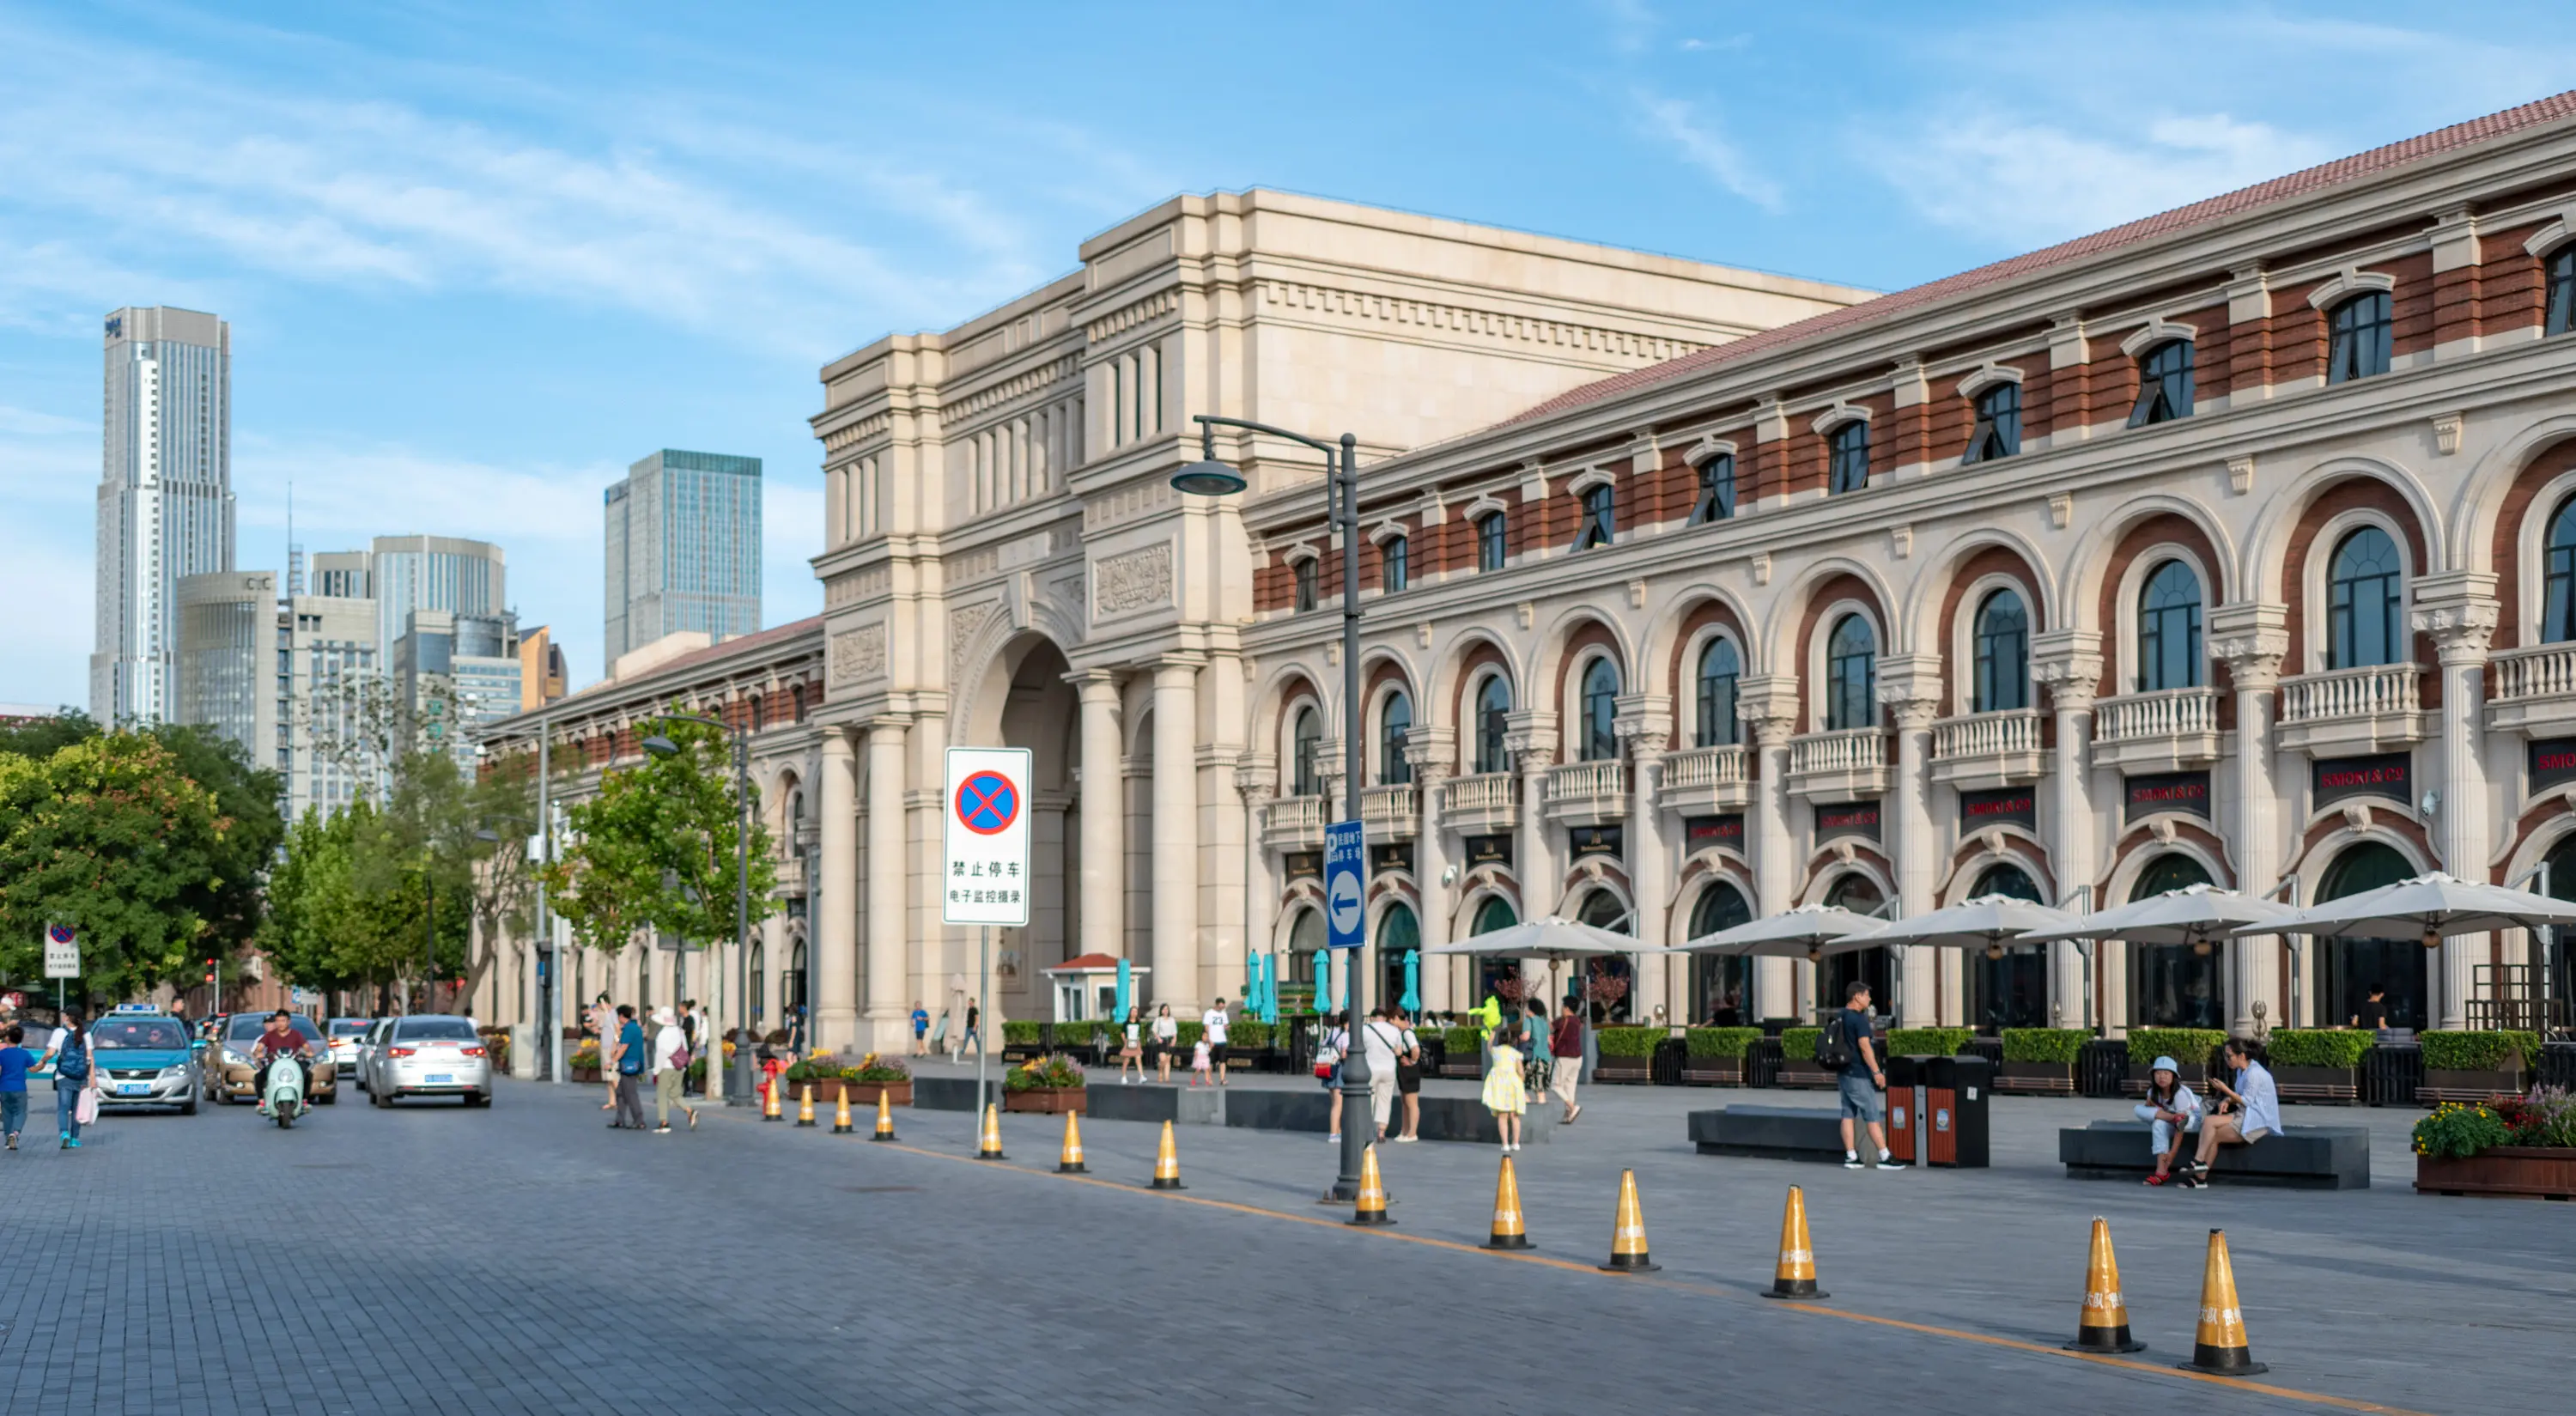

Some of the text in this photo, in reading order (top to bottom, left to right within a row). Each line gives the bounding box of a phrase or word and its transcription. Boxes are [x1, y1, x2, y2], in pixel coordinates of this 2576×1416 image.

[2322, 770, 2369, 788] SMOKI
[2371, 769, 2383, 783] &
[2132, 787, 2173, 803] SMOKI
[2175, 786, 2186, 799] &
[1967, 800, 2003, 817] SMOKI
[2005, 799, 2014, 813] &
[953, 860, 1020, 878] 禁止停车
[950, 889, 1020, 903] 电子监控摄录
[1212, 1017, 1223, 1025] 23
